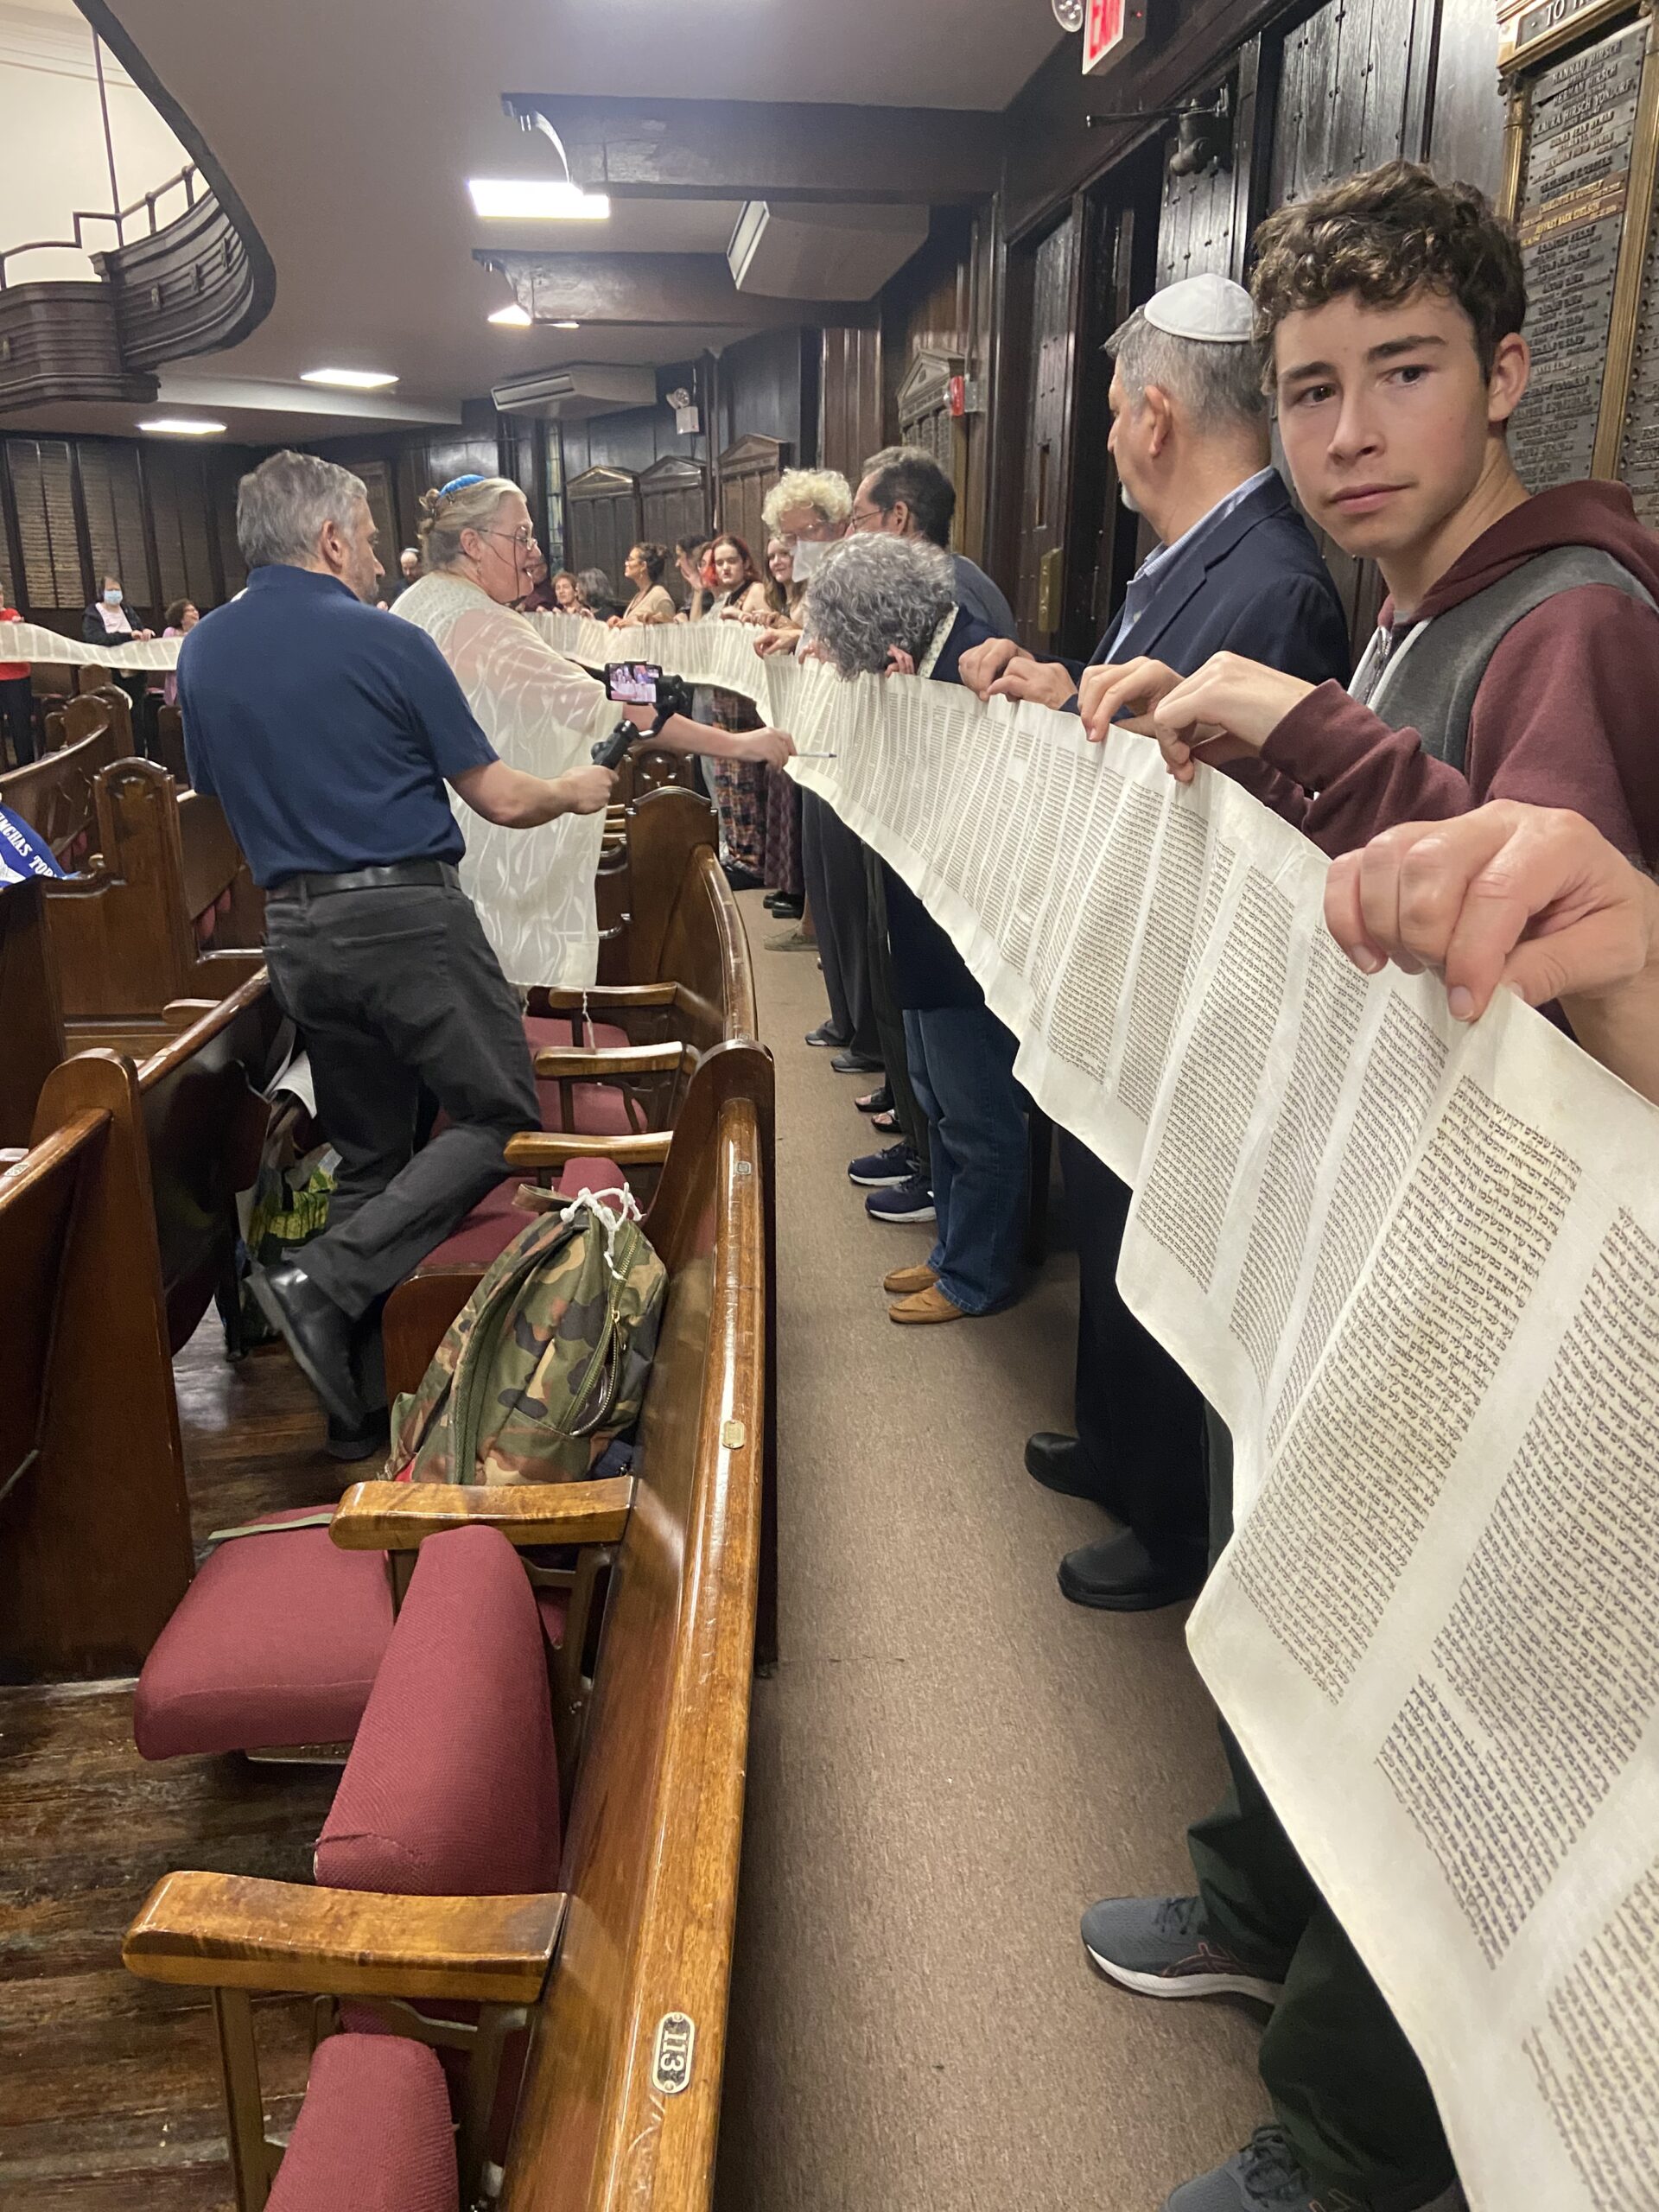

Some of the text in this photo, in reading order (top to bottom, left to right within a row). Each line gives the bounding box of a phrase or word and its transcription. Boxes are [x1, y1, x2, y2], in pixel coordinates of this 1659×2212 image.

[1546, 0, 1565, 27] TO
[1589, 62, 1619, 90] HIRSCH
[1563, 97, 1594, 123] HIRSCH
[1488, 1120, 1518, 1143] השבלים
[1524, 1127, 1550, 1148] שבלים
[1421, 1154, 1436, 1171] את
[1462, 1154, 1471, 1166] כל
[1517, 1141, 1551, 1166] ותבלענה
[1549, 1146, 1568, 1161] שבע
[1469, 1162, 1483, 1176] ואת
[1484, 1155, 1510, 1178] ותפעם
[1506, 1153, 1541, 1179] הבריאות
[1567, 1159, 1582, 1174] והנה
[1483, 1173, 1509, 1197] מצרים
[1511, 1173, 1533, 1194] בבקר
[1550, 1164, 1576, 1191] אחריהן
[1478, 1188, 1498, 1208] חלמו
[1535, 1189, 1548, 1202] ויהי
[1541, 1177, 1571, 1202] השבלים
[1462, 1197, 1474, 1211] את
[1497, 1205, 1512, 1219] את
[1511, 1192, 1536, 1216] חרטמי
[1548, 1201, 1565, 1219] חלום
[1414, 1205, 1425, 1222] אחד
[1474, 1207, 1511, 1236] המשקים
[1536, 1211, 1548, 1225] כל
[1463, 1217, 1482, 1234] היום
[1514, 1215, 1532, 1232] להם
[1547, 1221, 1558, 1236] את
[1437, 1235, 1453, 1253] חלום
[1451, 1229, 1466, 1245] בית
[1484, 1230, 1508, 1254] מזכיר
[1512, 1232, 1525, 1247] שר
[1531, 1228, 1551, 1251] פרעה
[1453, 1249, 1485, 1276] ונחלמה
[1468, 1241, 1501, 1269] במשמר
[1509, 1249, 1519, 1264] אני
[1527, 1243, 1546, 1264] וידבר
[1437, 1253, 1454, 1273] חלמו
[1522, 1260, 1539, 1279] חטאי
[1404, 1276, 1414, 1288] על
[1454, 1268, 1484, 1294] כפתרון
[1503, 1267, 1518, 1283] אתי
[1441, 1276, 1459, 1294] לשר
[1486, 1274, 1513, 1296] האפים
[1516, 1279, 1532, 1294] ויתן
[1412, 1287, 1431, 1306] השיב
[1431, 1287, 1447, 1303] איש
[1461, 1290, 1478, 1311] עבד
[1485, 1291, 1501, 1309] איש
[1514, 1294, 1525, 1307] שר
[1412, 1306, 1425, 1320] את
[1432, 1302, 1447, 1319] אתי
[1480, 1306, 1498, 1325] עברי
[1425, 1317, 1450, 1338] ויקרא
[1447, 1315, 1463, 1331] היה
[1499, 1322, 1513, 1339] נער
[1463, 1327, 1472, 1339] כן
[1481, 1325, 1494, 1340] את
[1449, 1335, 1471, 1359] פרעה
[1473, 1336, 1484, 1349] לנו
[1496, 1338, 1506, 1351] לנו
[1431, 1357, 1447, 1370] יוסף
[1485, 1346, 1499, 1366] פתר
[1471, 1354, 1495, 1378] וישלח
[1408, 1373, 1422, 1389] את
[1447, 1368, 1459, 1386] אל
[1435, 1376, 1461, 1402] שמעתי
[1459, 1382, 1480, 1406] פרעה
[1462, 1402, 1475, 1418] ואני
[1433, 1413, 1446, 1428] את
[660, 2030, 687, 2071] 113
